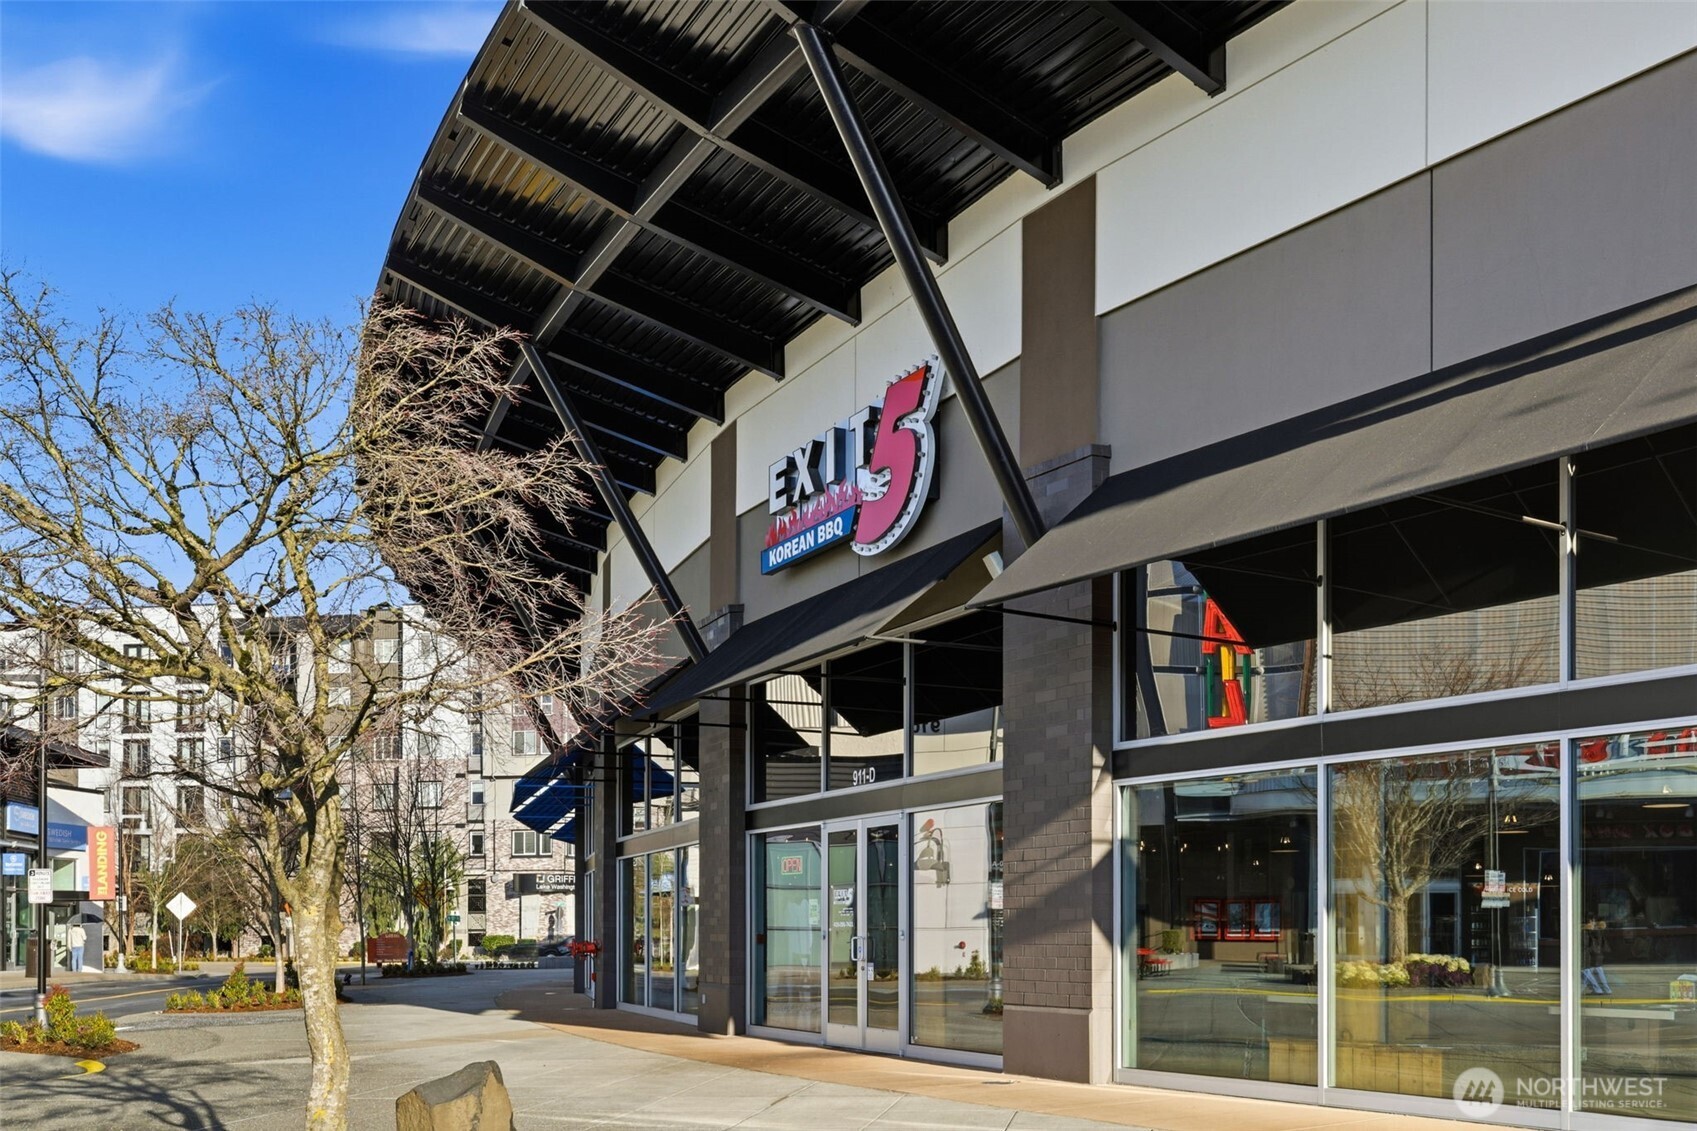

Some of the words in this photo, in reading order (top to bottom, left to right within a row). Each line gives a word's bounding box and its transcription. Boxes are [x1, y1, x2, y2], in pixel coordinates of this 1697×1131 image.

[769, 405, 872, 515] EXIT
[854, 362, 929, 546] 5
[768, 529, 816, 567] KOREAN
[817, 516, 843, 543] BBQ
[852, 766, 876, 786] 911-D
[96, 830, 108, 890] LANDING
[782, 858, 801, 874] OPEN
[547, 875, 576, 883] GRIFFI
